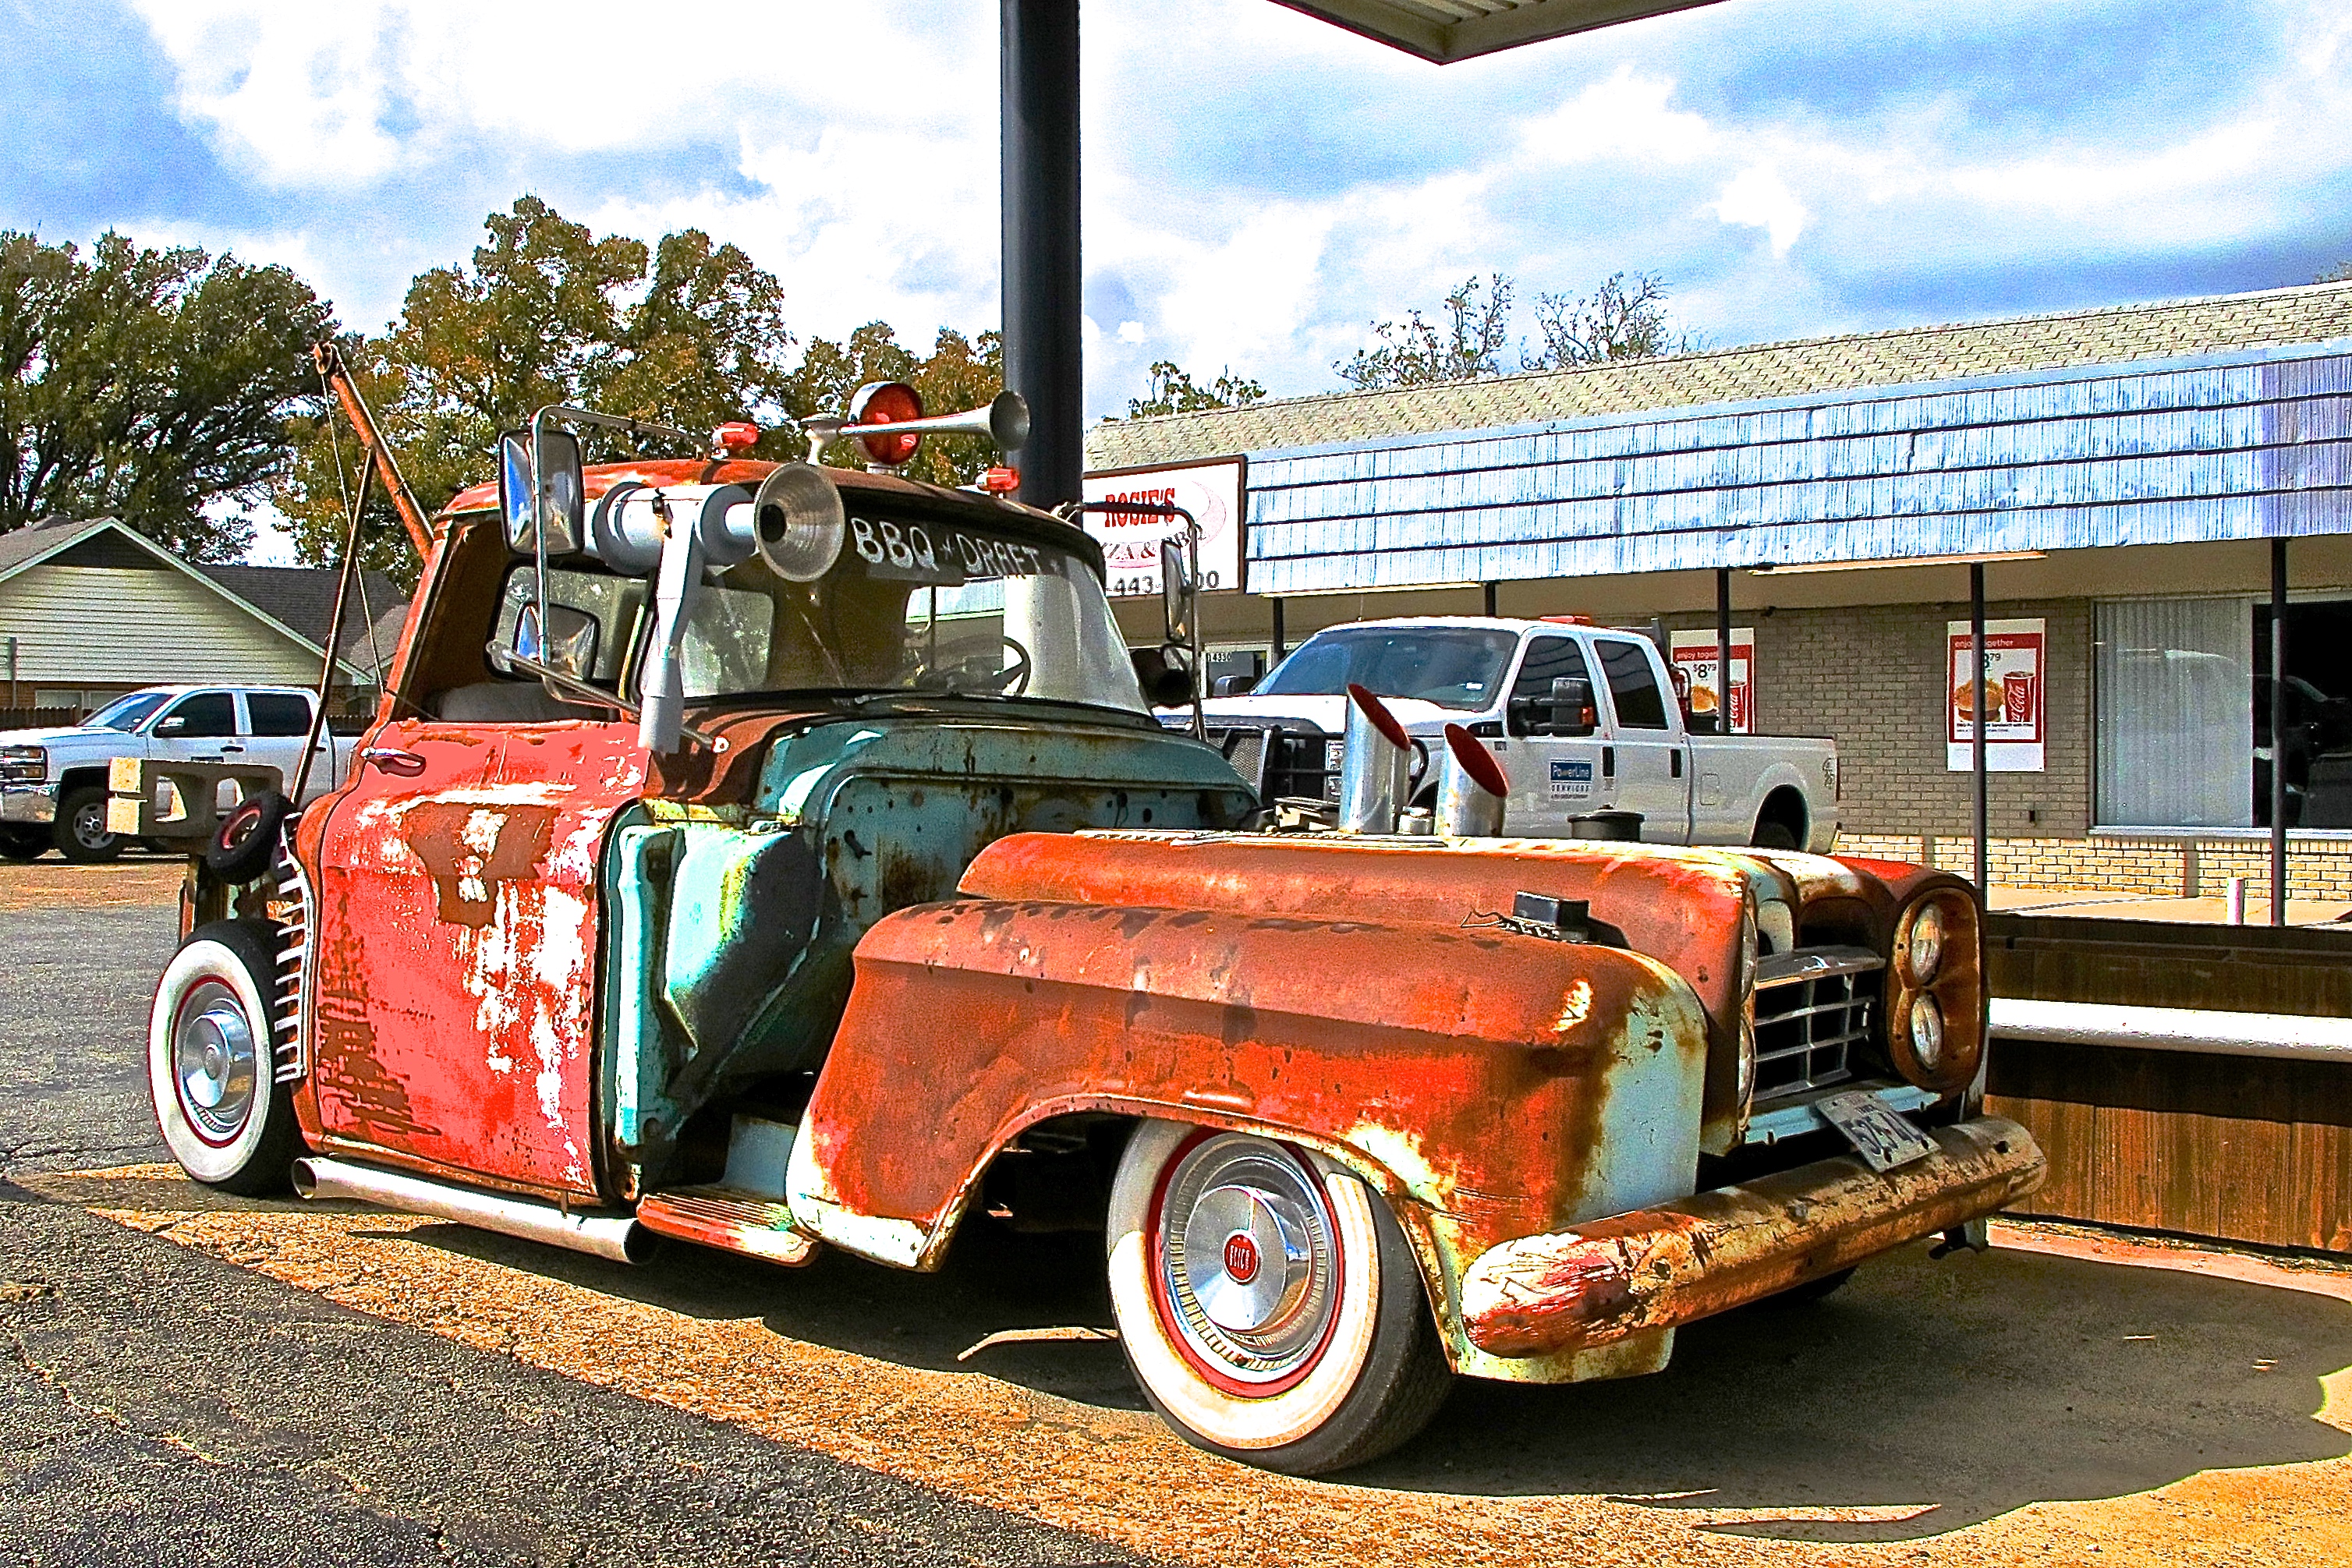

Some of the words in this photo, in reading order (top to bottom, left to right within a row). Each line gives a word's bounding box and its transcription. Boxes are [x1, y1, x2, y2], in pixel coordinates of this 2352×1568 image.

[1105, 488, 1174, 527] ROSIE'S
[851, 517, 939, 572] BBQ
[955, 533, 1040, 579] DRAFT
[1954, 640, 1973, 649] enjo
[1985, 639, 2014, 648] gether
[1553, 765, 1589, 777] PowerLine
